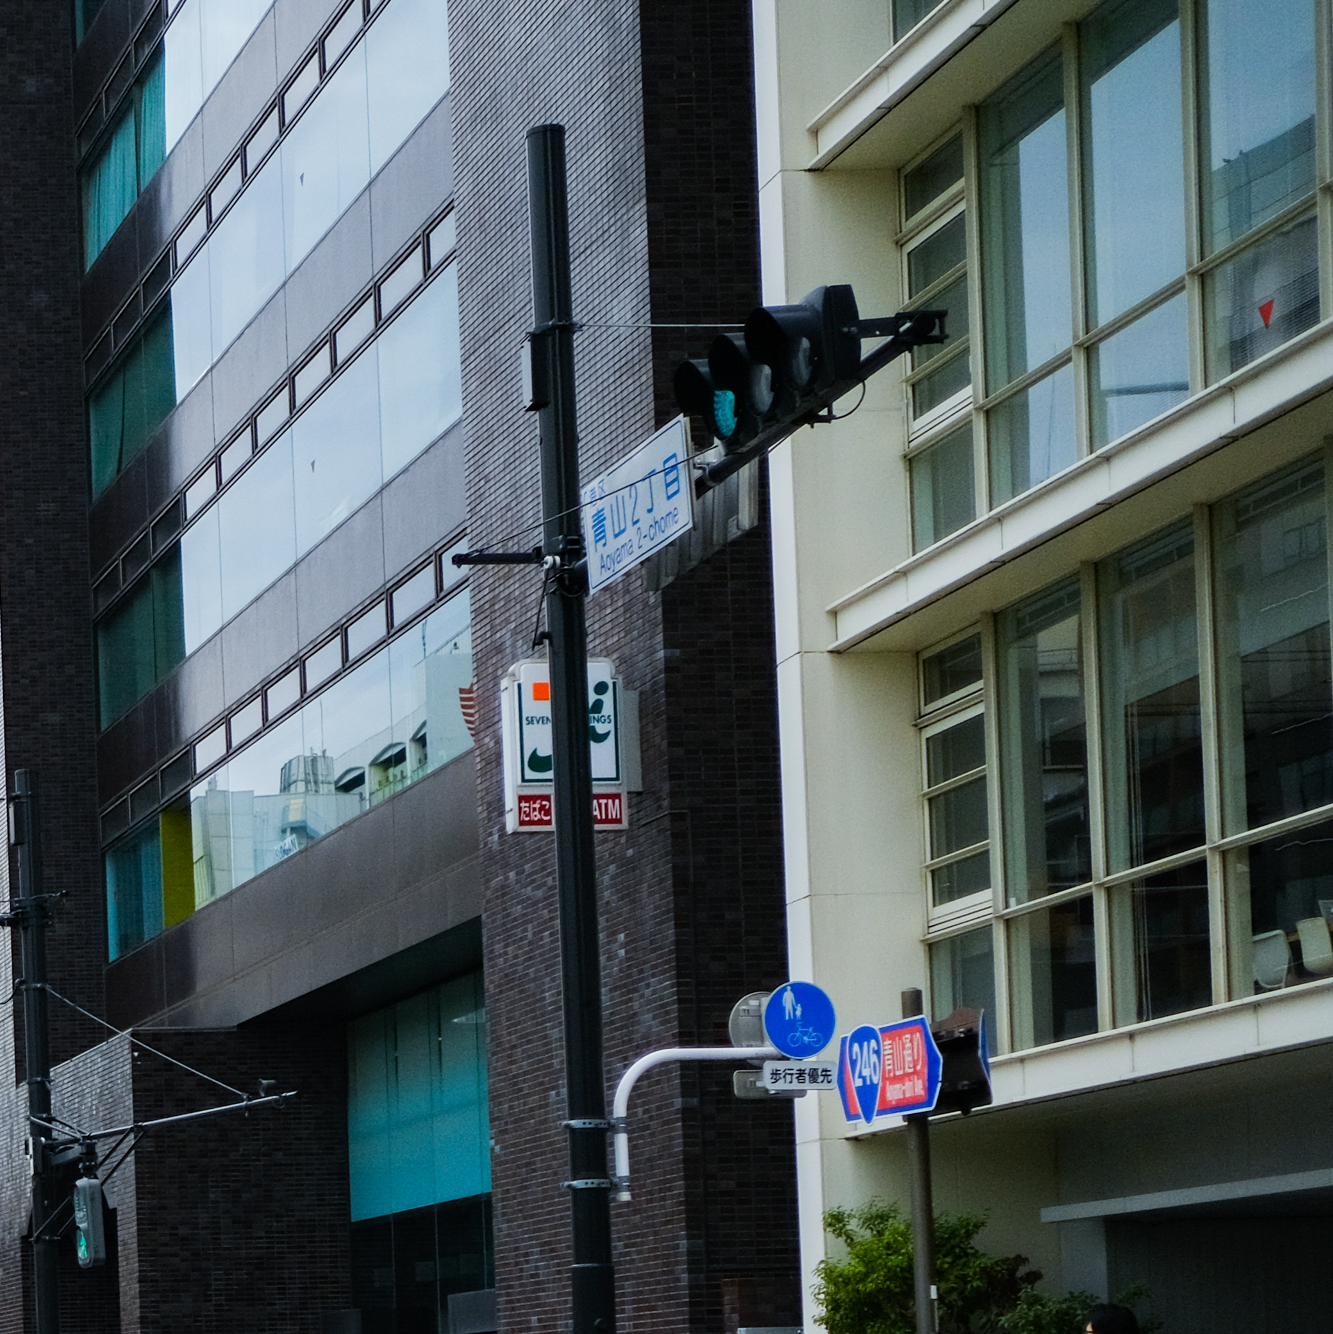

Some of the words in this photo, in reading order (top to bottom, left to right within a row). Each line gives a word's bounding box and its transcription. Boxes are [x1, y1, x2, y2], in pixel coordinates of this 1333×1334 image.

[591, 453, 681, 552] 青山2丁目
[599, 538, 634, 577] Aoyama
[636, 506, 680, 550] 2-chome
[520, 800, 551, 821] たばこ
[593, 798, 621, 820] ATM
[770, 1067, 833, 1084] 歩行者優先
[852, 1039, 880, 1087] 246
[883, 1032, 922, 1078] 青山通り
